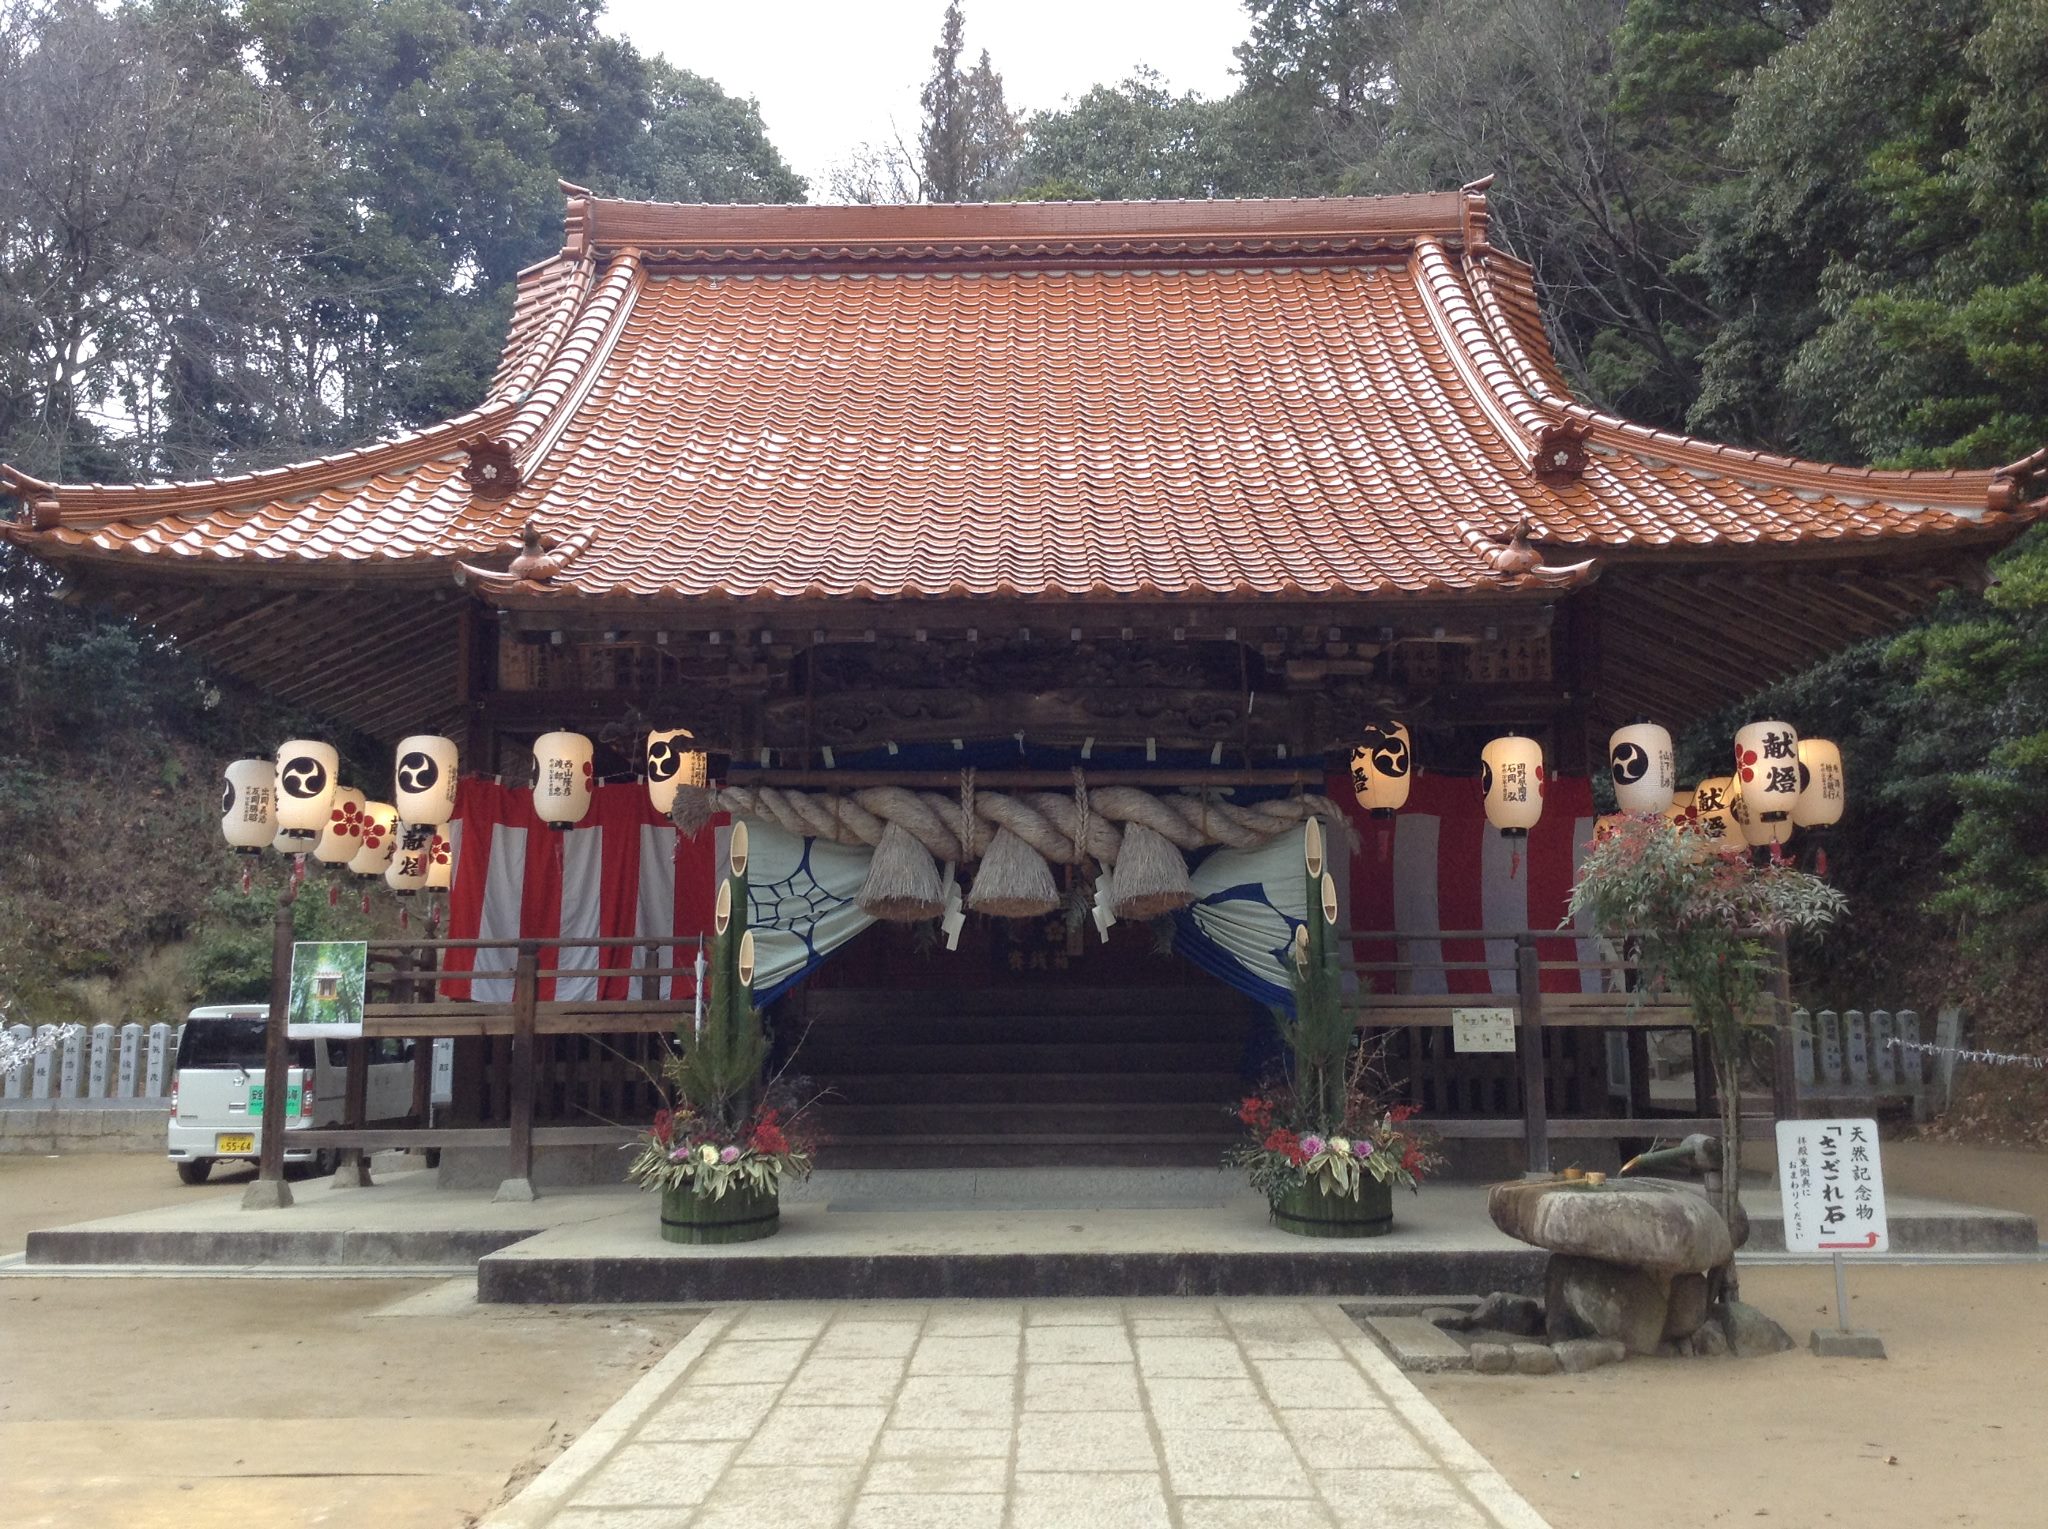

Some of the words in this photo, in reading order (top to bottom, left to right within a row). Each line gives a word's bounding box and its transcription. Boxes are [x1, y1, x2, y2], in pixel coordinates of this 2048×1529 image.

[1761, 731, 1797, 793] 献燈
[1789, 1161, 1804, 1240] おまわりください
[1819, 1126, 1846, 1235] 「さざれ石」
[1850, 1127, 1874, 1220] 天然記念物
